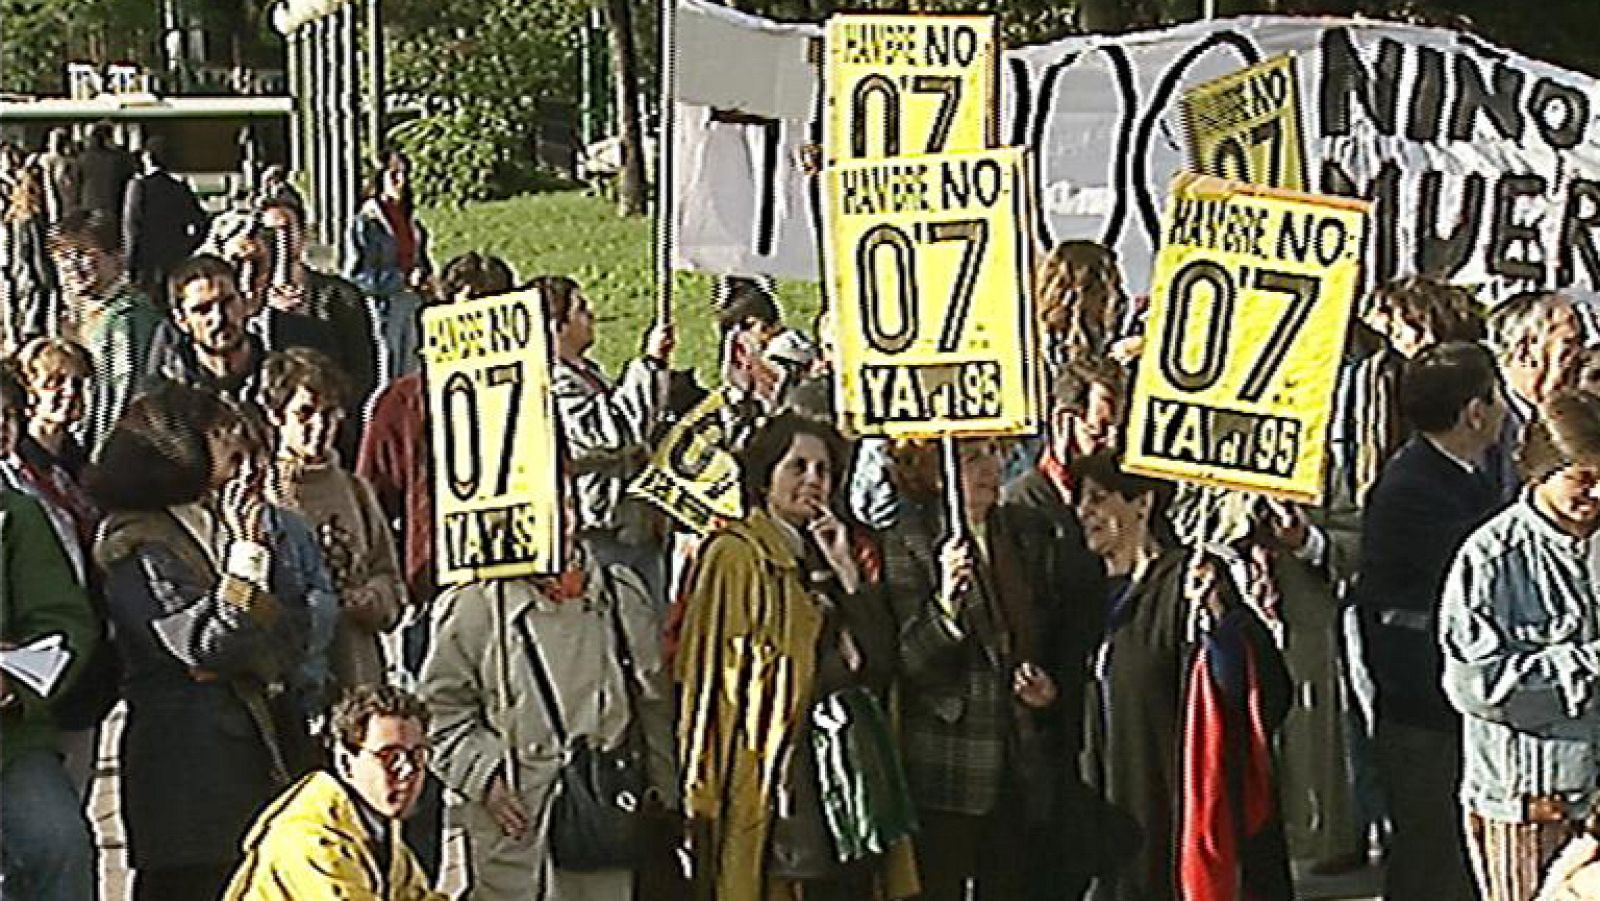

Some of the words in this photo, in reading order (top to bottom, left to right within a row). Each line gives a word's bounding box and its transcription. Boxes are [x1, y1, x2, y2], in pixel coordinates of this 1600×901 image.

[926, 24, 977, 67] NO
[1250, 67, 1286, 117] NO
[1320, 26, 1591, 149] NIÑO
[856, 217, 990, 355] 0'7
[488, 301, 532, 353] NO
[1159, 258, 1322, 404] 0'7
[865, 366, 922, 419] YA
[962, 362, 1000, 417] 95
[441, 360, 524, 503] 0'7
[1152, 401, 1204, 460] YA
[1254, 417, 1297, 475] 95
